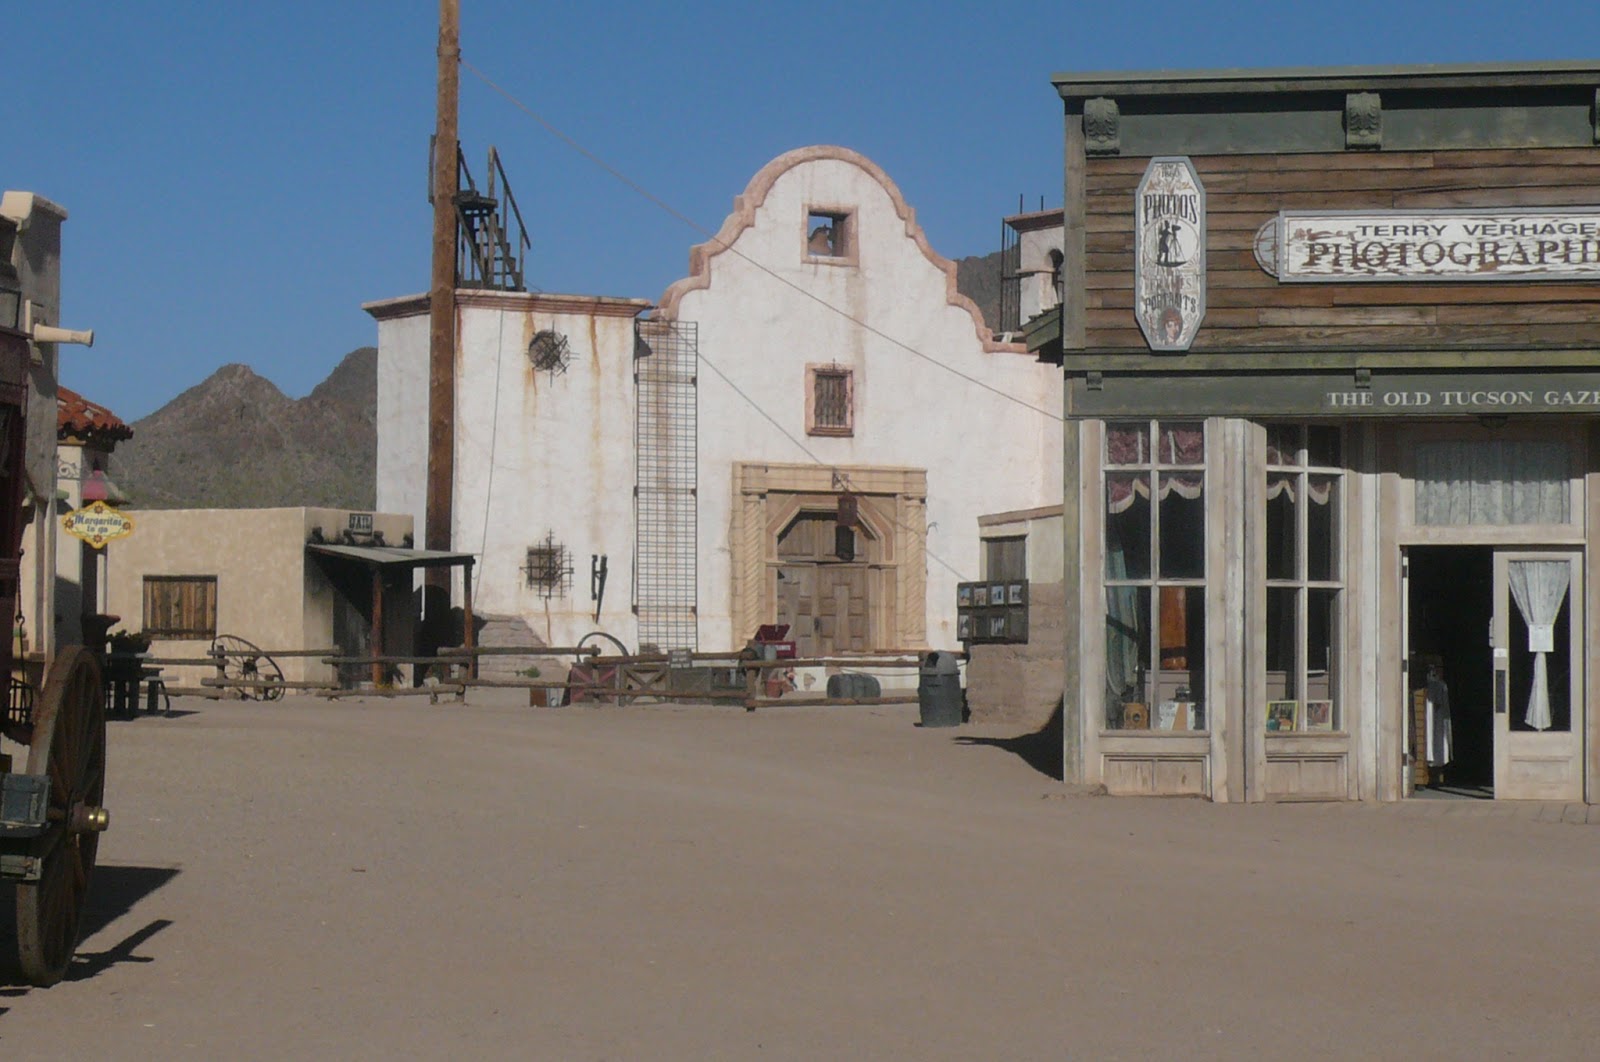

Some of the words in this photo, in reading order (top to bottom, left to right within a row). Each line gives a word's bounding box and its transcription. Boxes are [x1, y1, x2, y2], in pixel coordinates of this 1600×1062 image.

[1143, 194, 1197, 225] PHOTOS
[1356, 224, 1447, 236] TERRY
[1463, 222, 1597, 236] VERHAGE
[1327, 392, 1374, 406] THE
[1383, 391, 1431, 406] OLD
[1440, 391, 1533, 406] TUCSON
[75, 514, 122, 526] Margaritas
